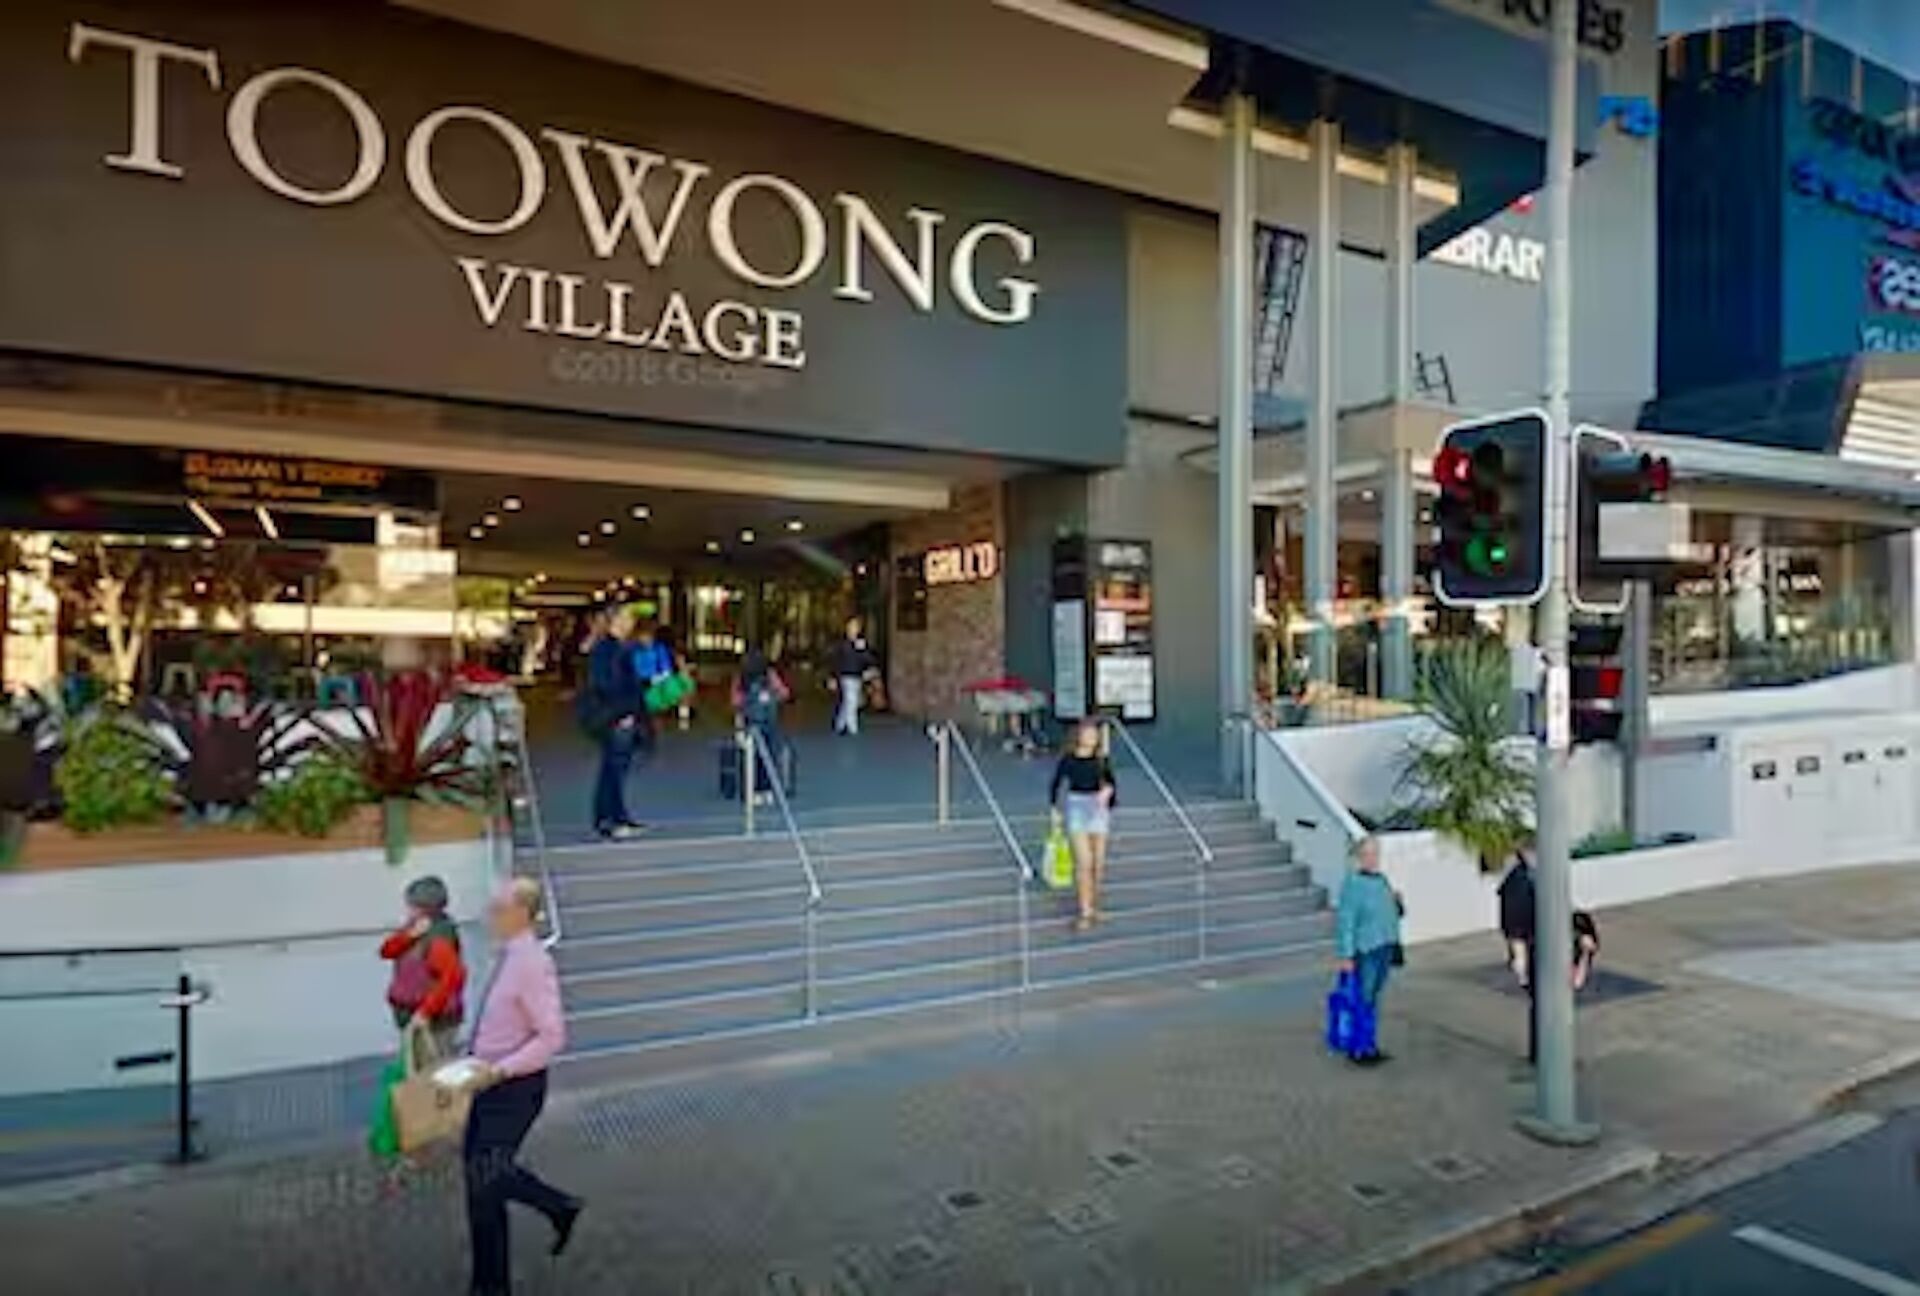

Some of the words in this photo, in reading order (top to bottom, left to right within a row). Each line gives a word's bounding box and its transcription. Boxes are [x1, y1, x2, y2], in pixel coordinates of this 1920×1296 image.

[69, 25, 1039, 323] TOOWONG
[1430, 226, 1545, 281] BRAR
[458, 258, 806, 369] VILLAGE
